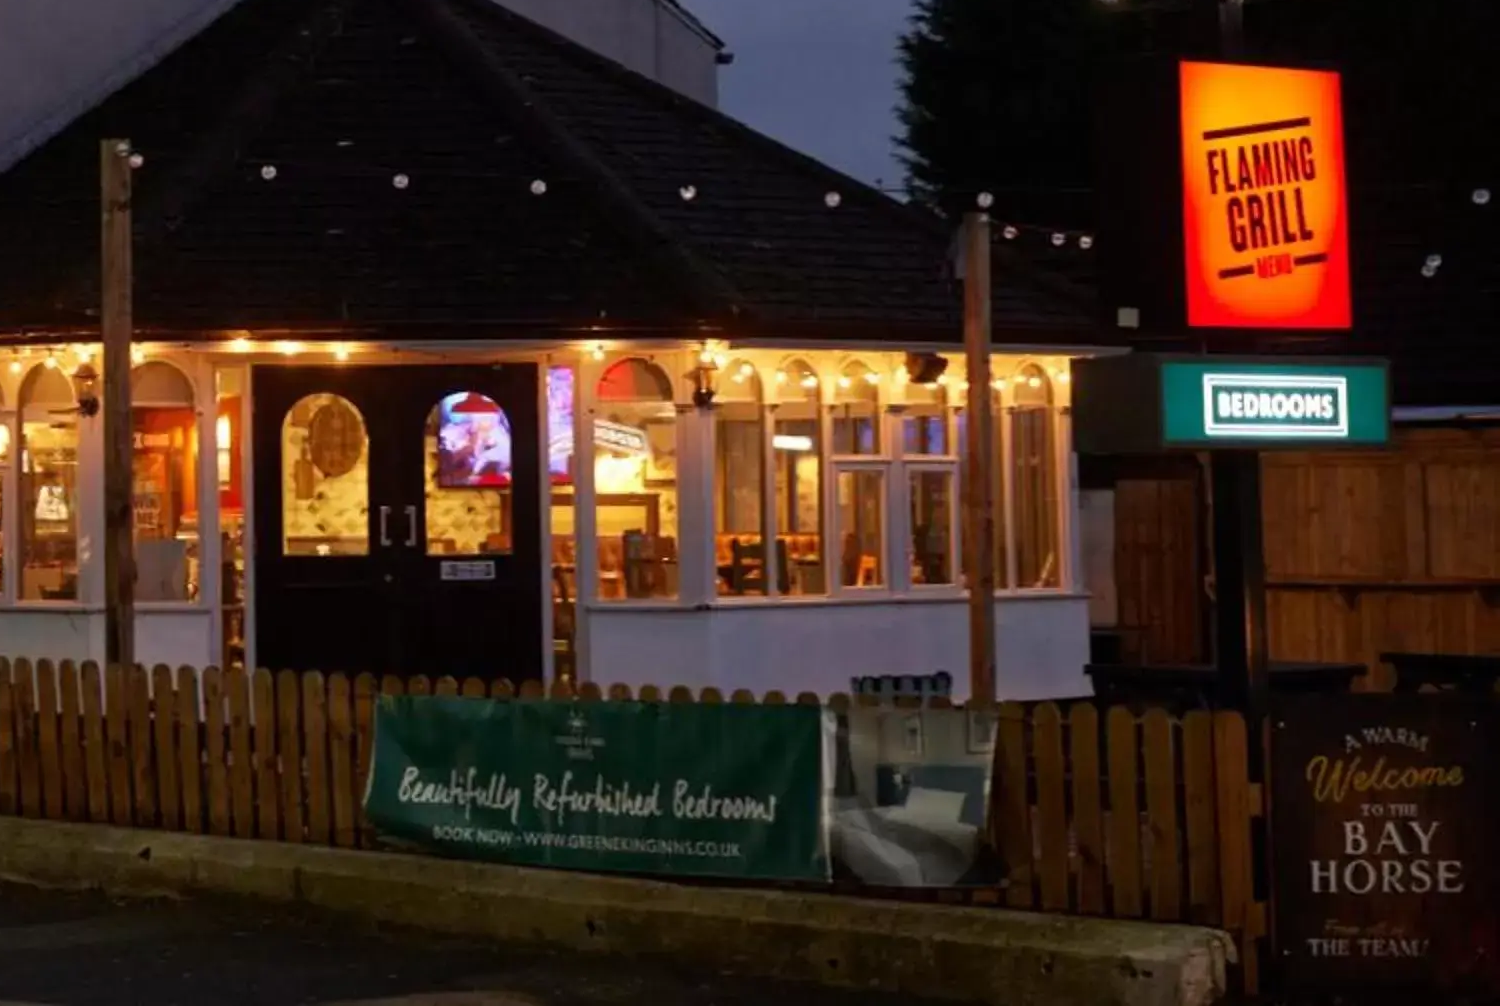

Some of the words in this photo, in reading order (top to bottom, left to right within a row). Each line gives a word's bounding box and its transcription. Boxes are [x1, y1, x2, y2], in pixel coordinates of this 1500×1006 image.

[1206, 136, 1317, 195] FLAMING
[1226, 188, 1313, 253] GRILL
[1217, 391, 1334, 419] BEDROOMS
[1344, 734, 1362, 753] A
[1362, 726, 1429, 752] WARM
[398, 766, 521, 825] Beautifully
[533, 770, 663, 825] Refurbished
[672, 779, 776, 823] Bedrooms
[1305, 755, 1465, 802] Welcome
[1360, 803, 1384, 817] TO
[1390, 803, 1418, 817] THE
[432, 825, 473, 843] BOOK
[476, 828, 512, 845] NOW
[1343, 820, 1442, 855] BAY
[1309, 859, 1465, 893] HORSE
[1304, 938, 1350, 958] THE
